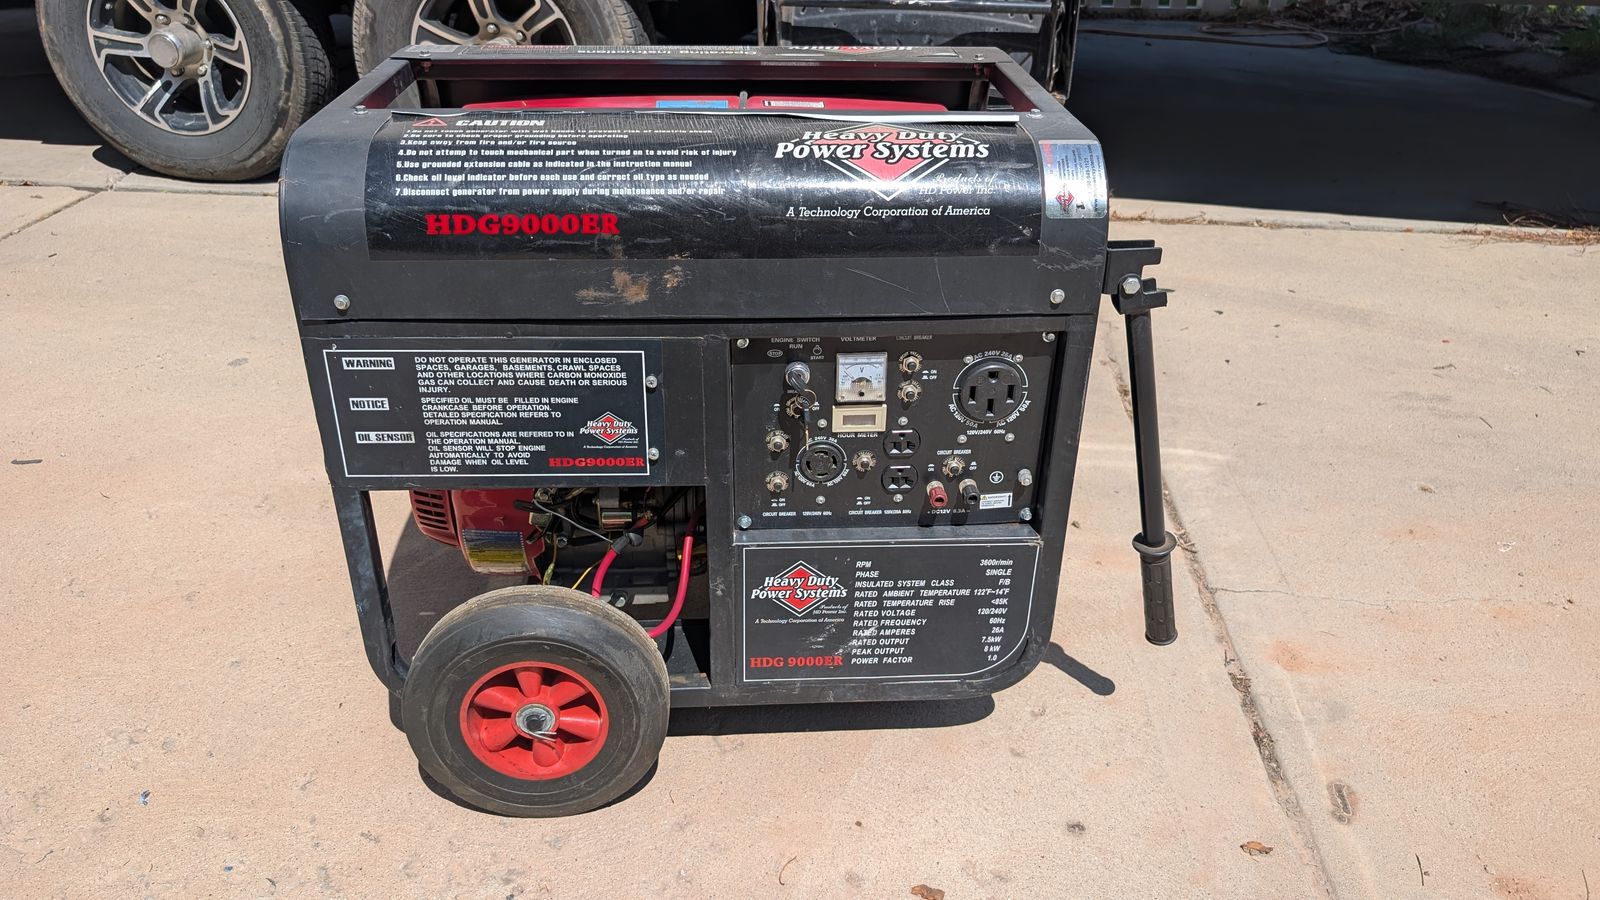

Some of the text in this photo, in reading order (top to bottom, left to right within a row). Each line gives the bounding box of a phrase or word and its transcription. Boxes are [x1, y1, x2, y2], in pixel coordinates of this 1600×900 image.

[802, 131, 962, 142] Heavy Duty
[774, 142, 989, 163] Power Systems
[395, 188, 449, 196] 7.Disconnect
[552, 188, 580, 197] supply
[583, 188, 609, 196] during
[699, 188, 725, 196] repair
[939, 187, 974, 195] Power
[786, 206, 991, 218] A Technology Corporation of America
[426, 214, 620, 235] HDG9000ER
[345, 360, 392, 368] WARNING
[416, 364, 451, 372] SPACES,
[455, 364, 497, 372] GARAGES,
[352, 400, 387, 409] NOTICE
[996, 420, 1006, 428] AC
[605, 428, 638, 436] Systems
[358, 433, 412, 441] OIL SENSOR
[549, 458, 644, 467] HDG9000ER
[764, 576, 839, 588] Heavy Duty
[751, 589, 848, 600] Power Systems
[750, 656, 843, 667] HDG 9000ER
